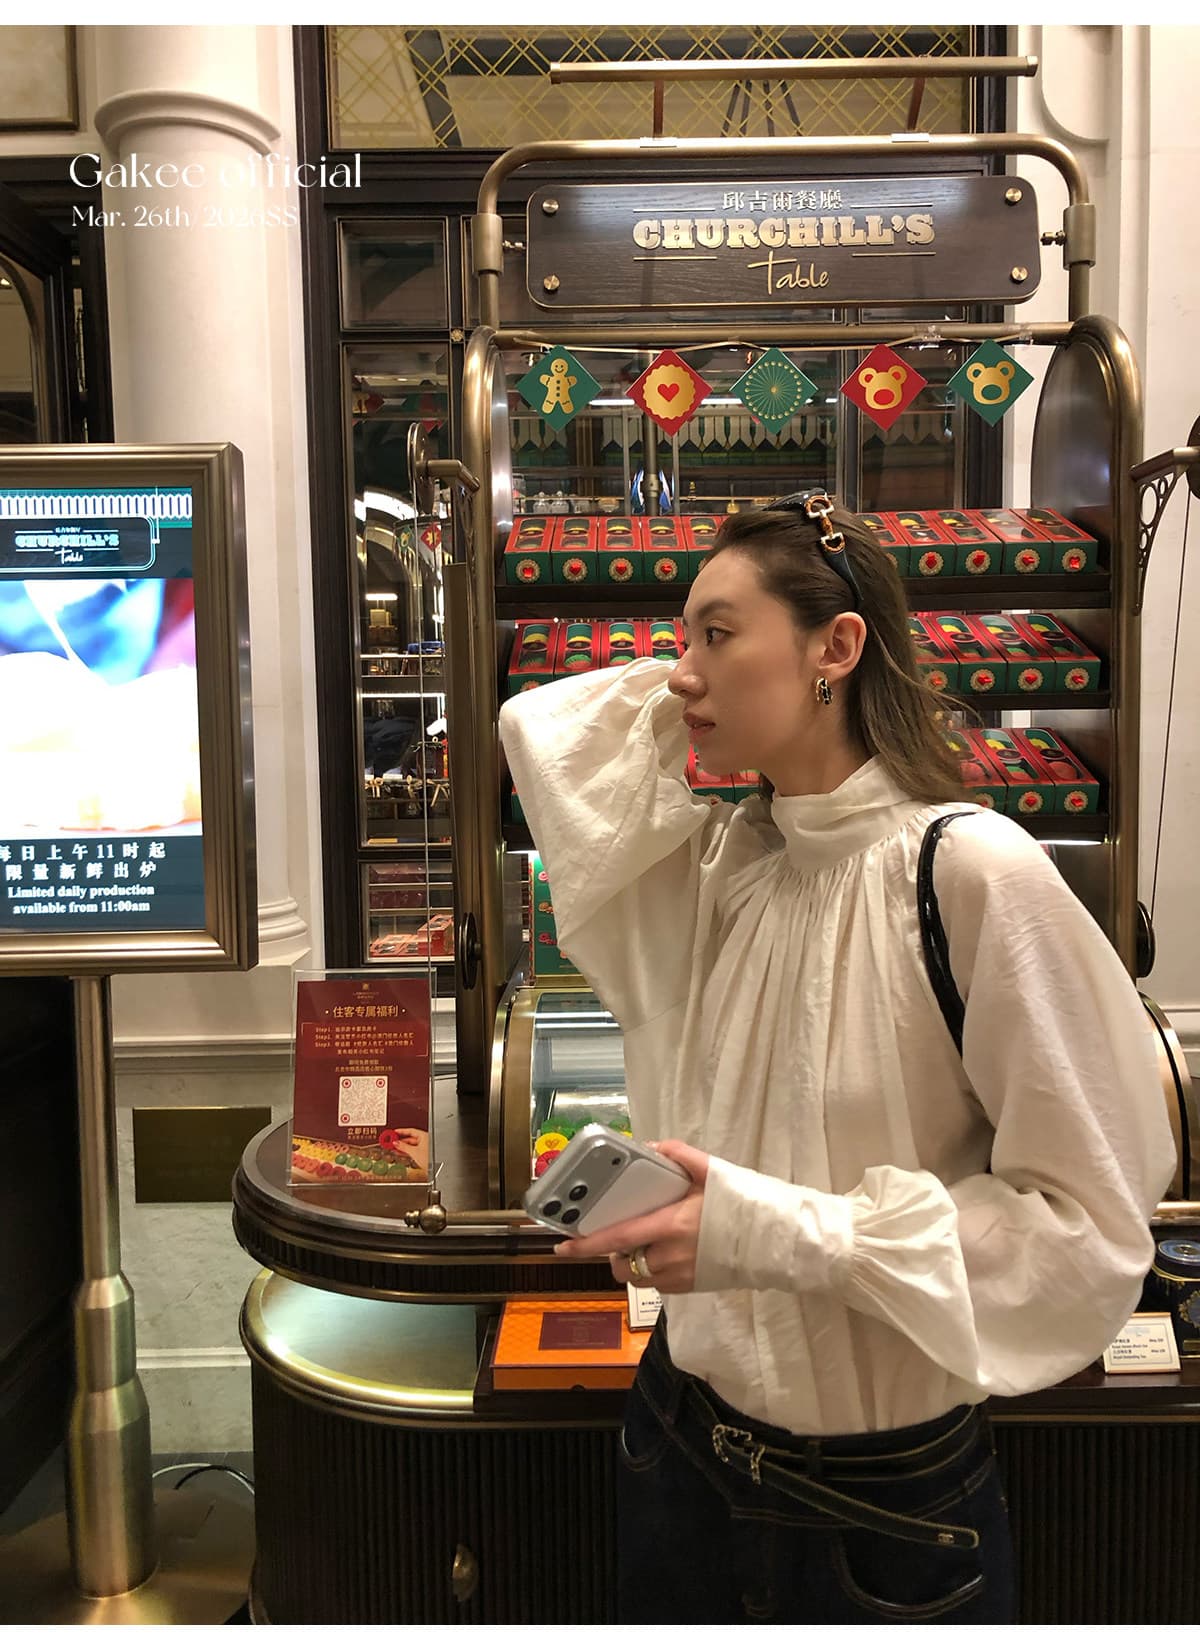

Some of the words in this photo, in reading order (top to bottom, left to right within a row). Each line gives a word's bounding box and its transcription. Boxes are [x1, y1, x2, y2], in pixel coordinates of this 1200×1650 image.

[721, 188, 844, 213] 邱吉爾餐廳
[633, 212, 936, 250] CHURCHILL'S
[747, 250, 831, 296] Table
[7, 885, 55, 899] Limited
[57, 884, 87, 899] daily
[89, 883, 155, 899] production
[13, 902, 66, 915] available
[68, 901, 99, 913] from
[100, 900, 151, 913] 11:00am
[332, 1005, 399, 1019] 住客专属福利
[347, 1127, 378, 1135] 立即扫码
